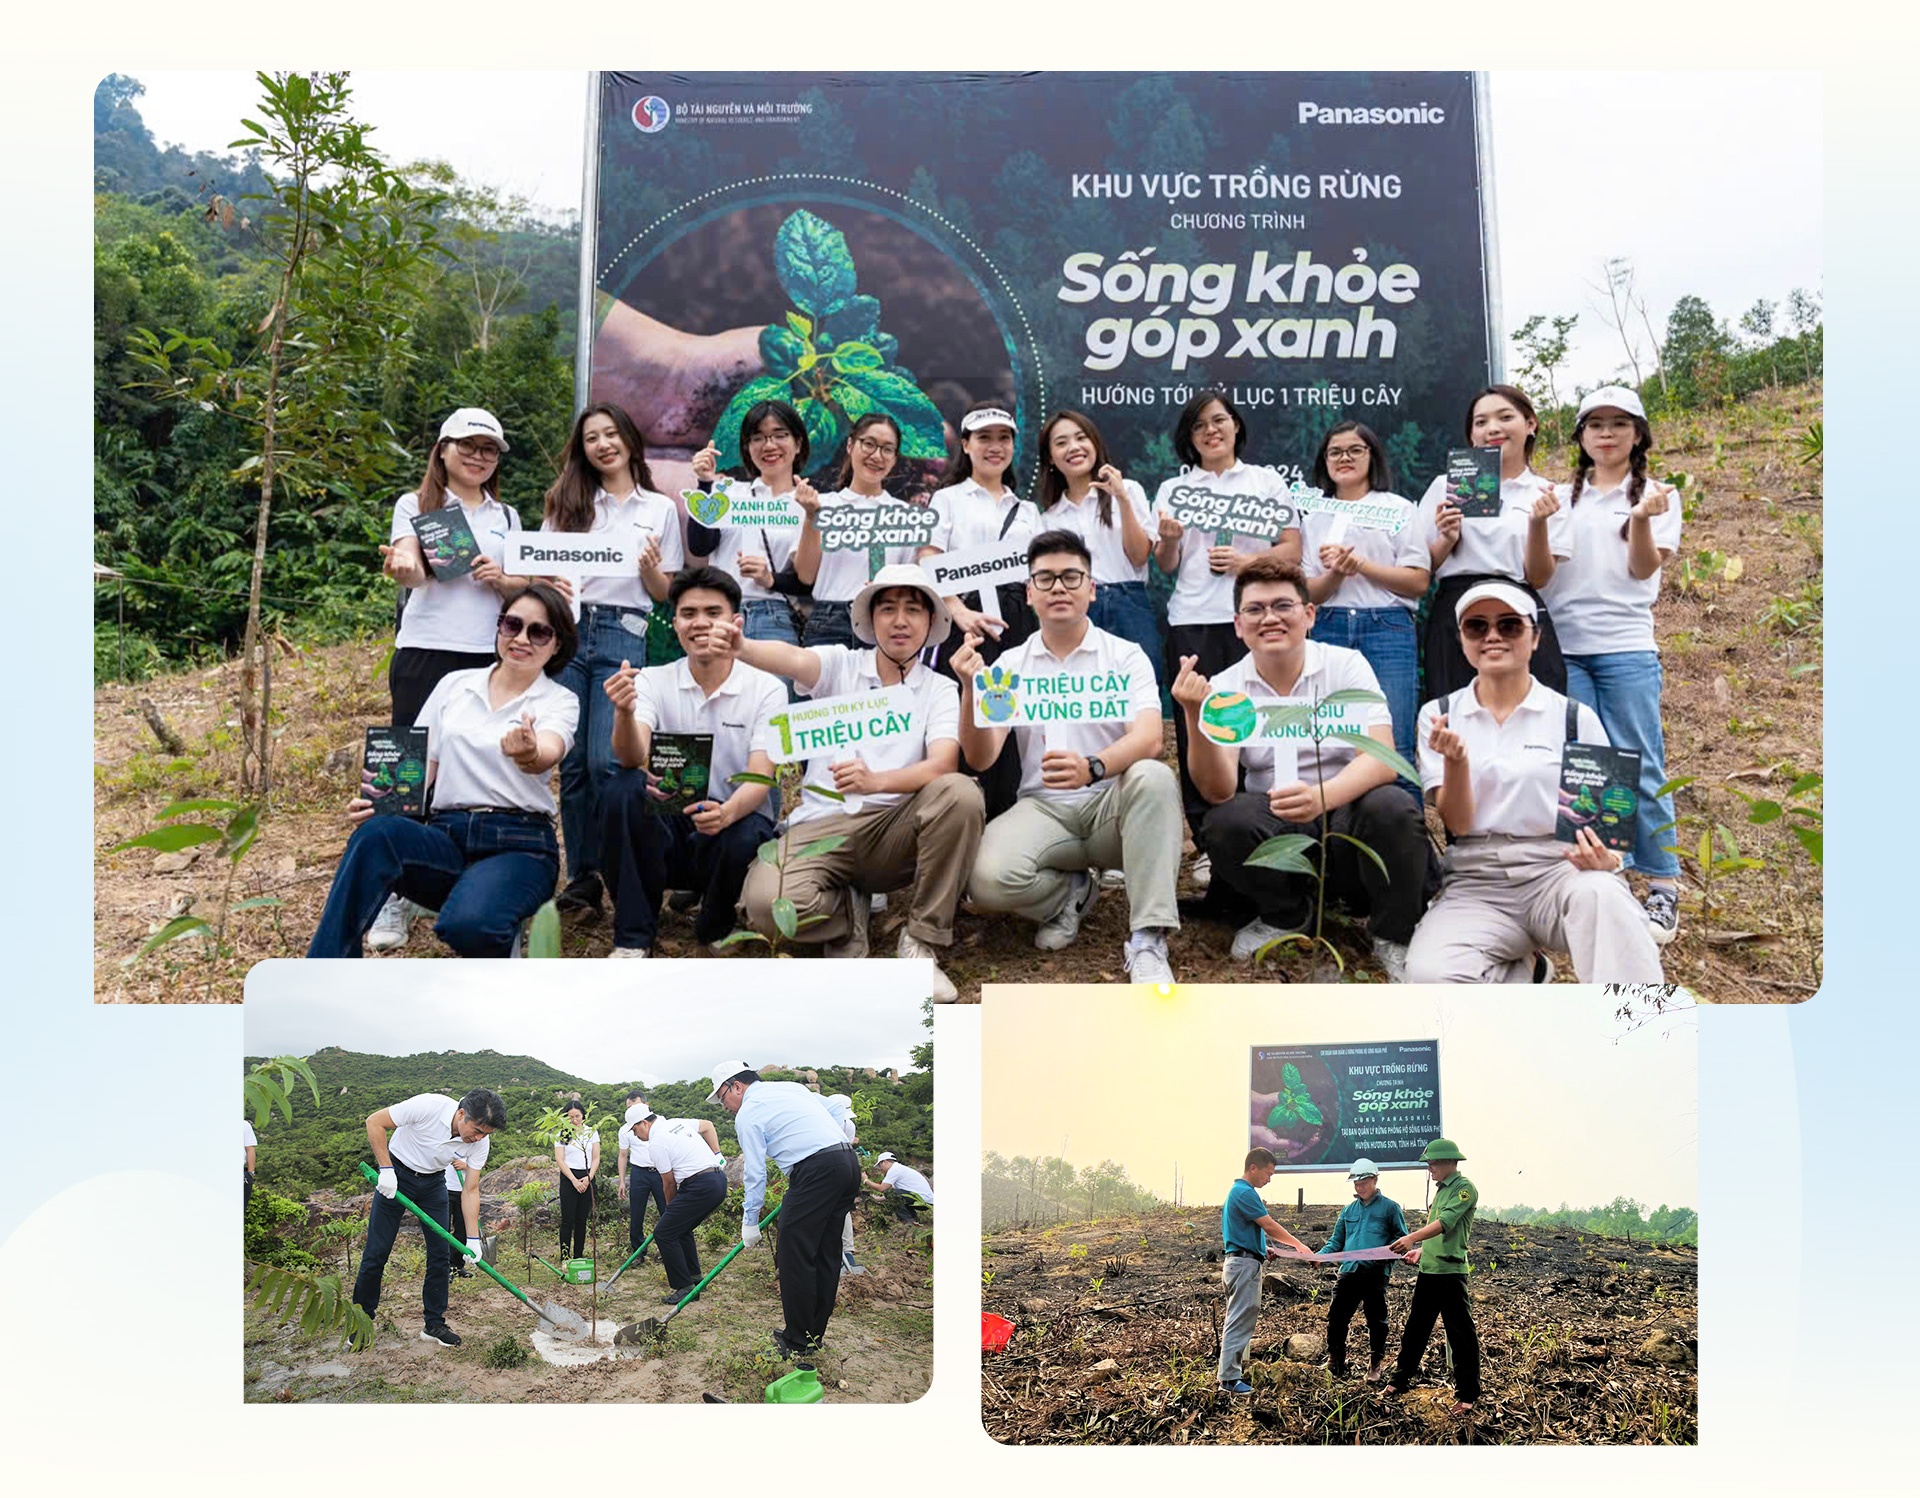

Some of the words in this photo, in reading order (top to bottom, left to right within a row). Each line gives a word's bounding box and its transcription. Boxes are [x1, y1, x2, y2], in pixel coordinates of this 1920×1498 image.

[1299, 102, 1445, 125] Panasonic
[1072, 174, 1132, 198] KHU
[1140, 172, 1201, 204] VỰC
[1209, 165, 1311, 198] TRỒNG
[1319, 169, 1402, 198] RỪNG
[1170, 212, 1247, 229] CHƯƠNG
[1250, 210, 1305, 229] TRÌNH
[1058, 246, 1236, 316] Sống
[1245, 247, 1420, 304] khỏe
[1083, 305, 1222, 371] góp
[1224, 305, 1398, 359] xanh
[1082, 383, 1155, 405] HƯỚNG
[1233, 387, 1276, 410] LỤC
[1280, 387, 1288, 405] 1
[1293, 384, 1357, 409] TRIỆU
[1361, 384, 1402, 405] CÂY
[732, 501, 764, 512] XANH
[767, 498, 789, 512] ĐẤT
[1172, 488, 1231, 515] Sống
[1231, 498, 1290, 522] khỏe
[817, 507, 876, 530] Sống
[878, 507, 936, 525] khỏe
[1178, 508, 1222, 529] góp
[1221, 516, 1279, 538] xanh
[825, 526, 871, 548] góp
[871, 525, 928, 543] xanh
[520, 545, 623, 563] Panasonic
[935, 551, 1029, 583] Panasonic
[1023, 672, 1084, 699] TRIỆU
[1090, 670, 1130, 692] CÂY
[1024, 698, 1082, 721] VỮNG
[1089, 694, 1130, 718] ĐẤT
[769, 713, 793, 755] 1
[795, 720, 863, 750] TRIỆU
[868, 710, 912, 737] CÂY
[1399, 1045, 1431, 1053] Panasonic
[1348, 1066, 1364, 1075] KHU
[1364, 1065, 1381, 1076] VỰC
[1381, 1062, 1406, 1074] TRỒNG
[1406, 1062, 1428, 1073] RỪNG
[1352, 1089, 1392, 1102] Sống
[1394, 1087, 1434, 1099] khỏe
[1358, 1100, 1389, 1113] góp
[1390, 1098, 1429, 1109] xanh
[1381, 1114, 1431, 1122] PANASONIC
